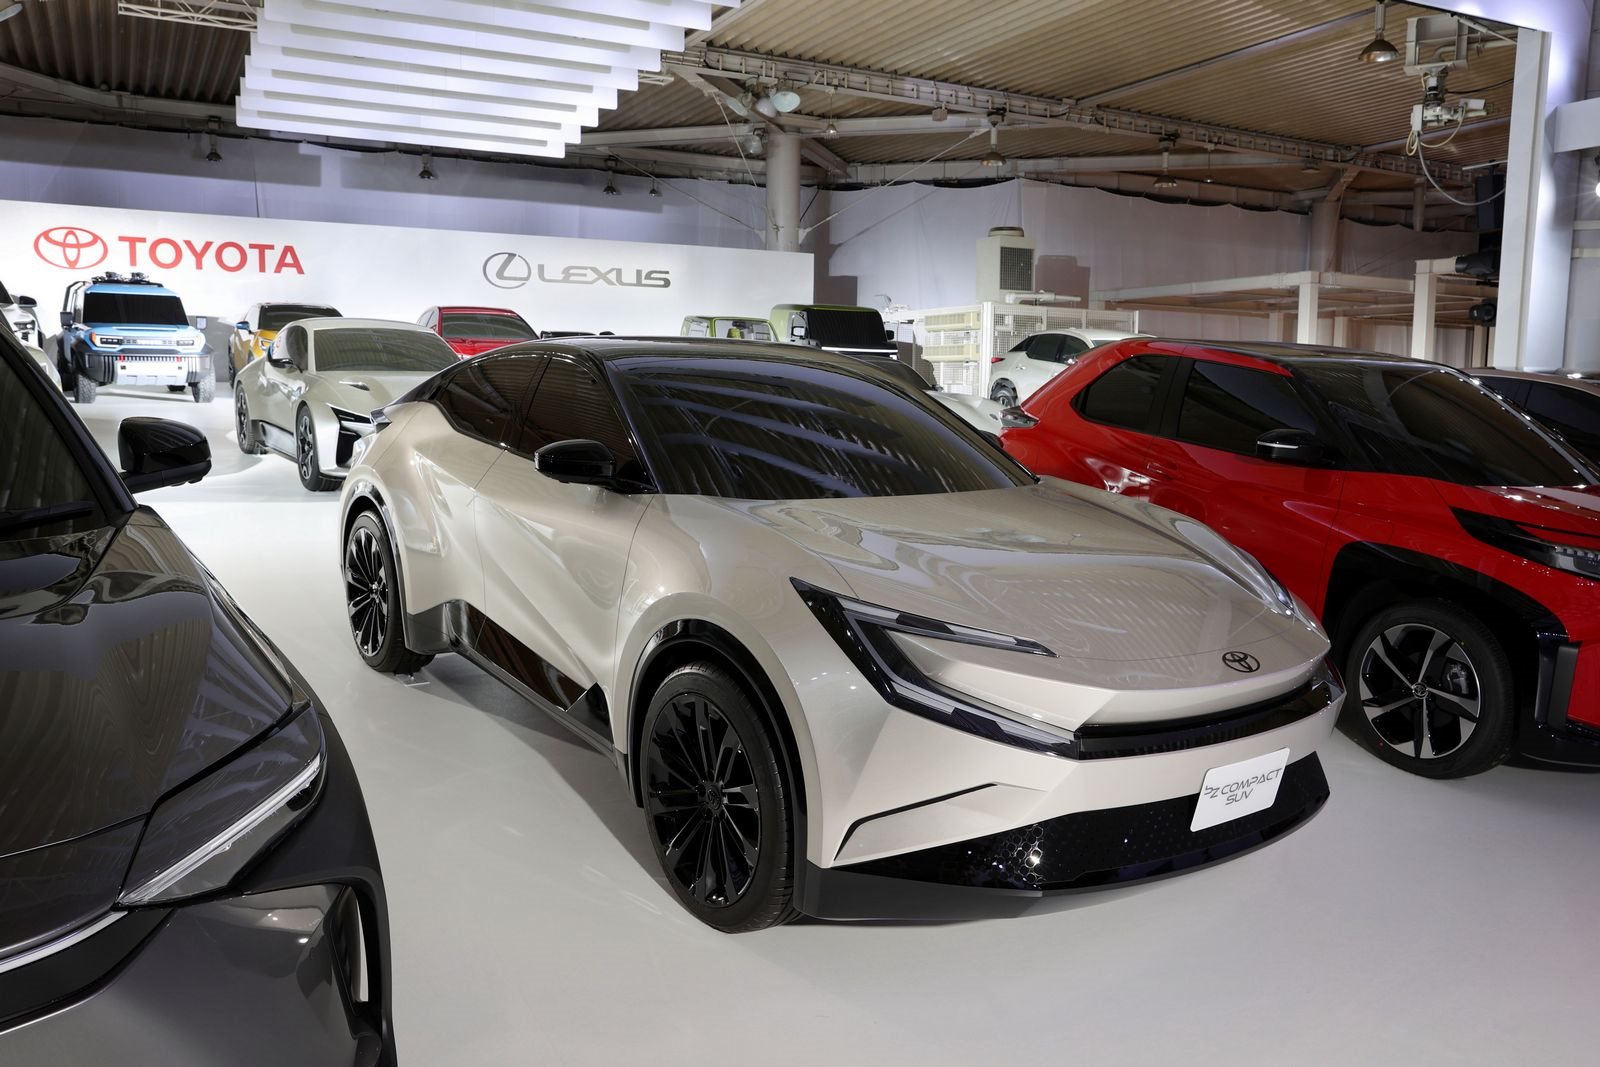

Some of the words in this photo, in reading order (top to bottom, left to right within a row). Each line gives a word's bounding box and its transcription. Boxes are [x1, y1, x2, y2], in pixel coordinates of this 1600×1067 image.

[118, 236, 305, 275] TOYOTA
[537, 263, 671, 289] LEXUS
[1220, 767, 1282, 795] COMPACT
[1225, 788, 1254, 805] SUV
